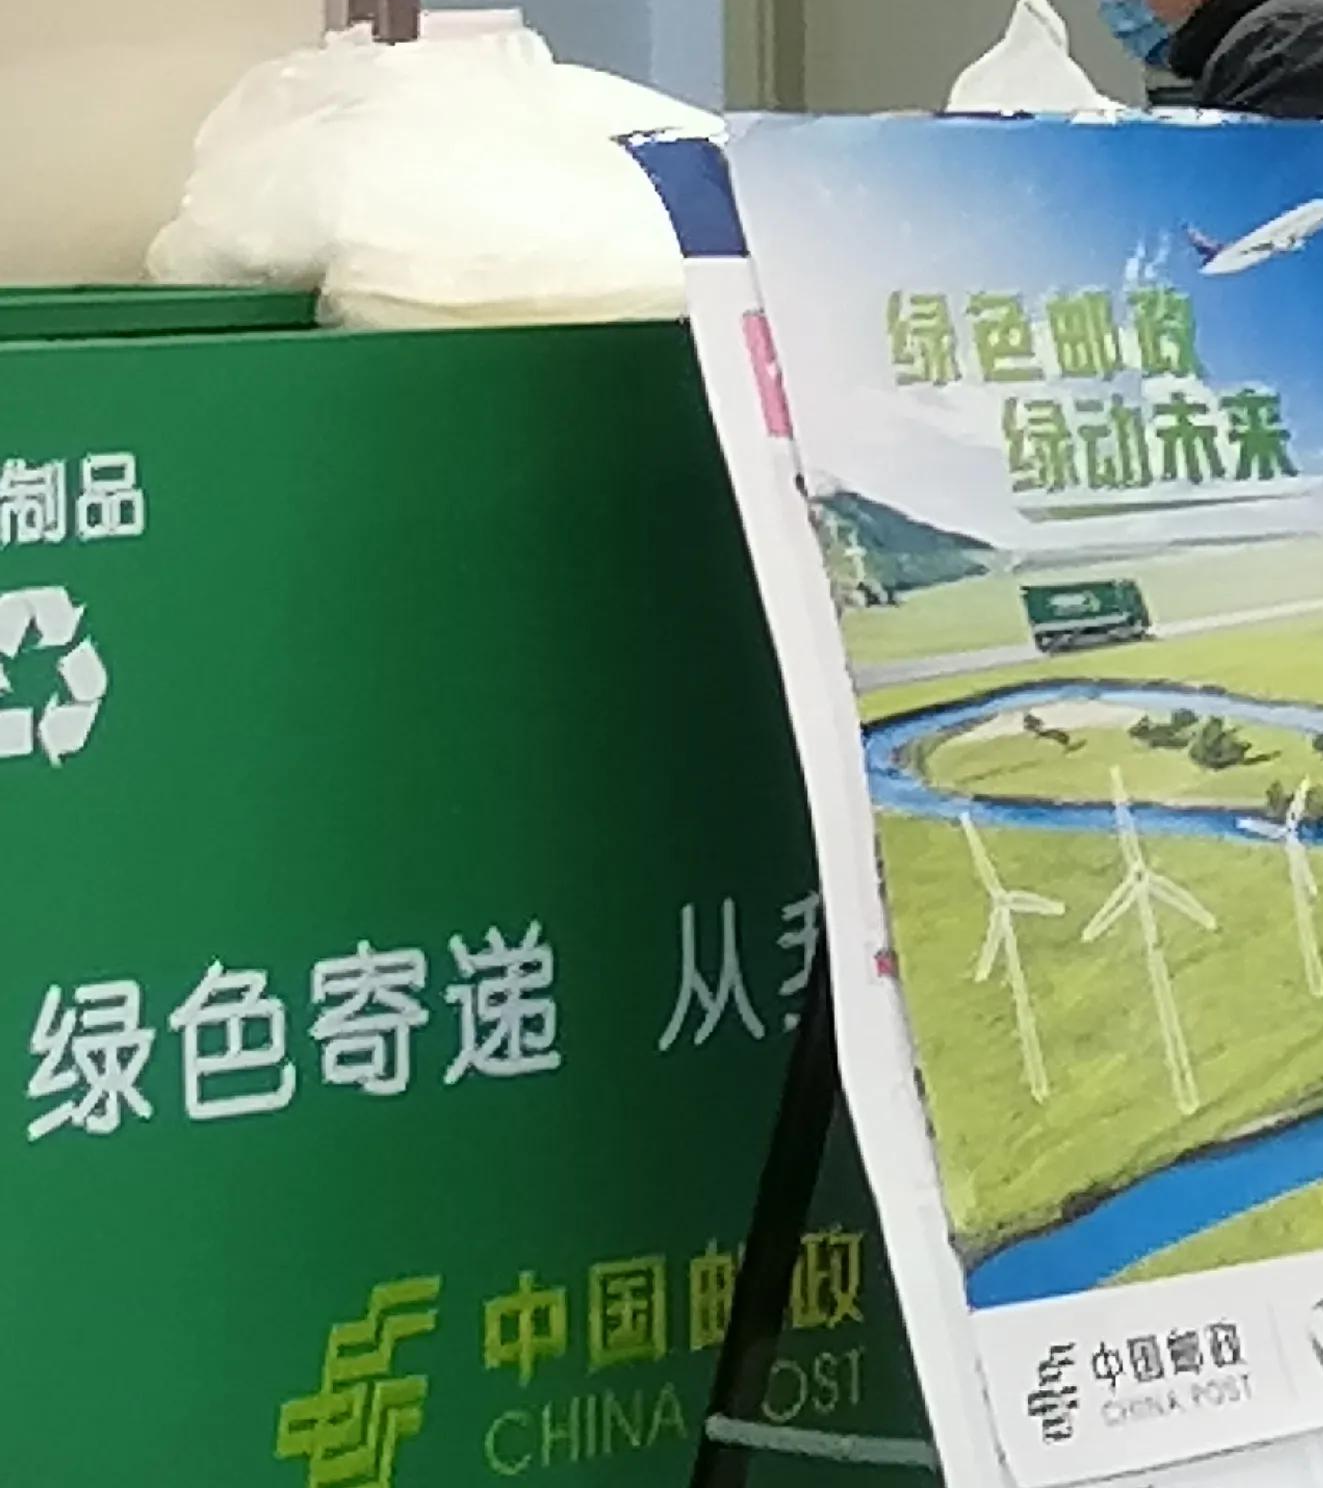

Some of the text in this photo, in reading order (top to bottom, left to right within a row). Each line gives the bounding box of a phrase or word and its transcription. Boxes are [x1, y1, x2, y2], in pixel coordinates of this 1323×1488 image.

[886, 288, 1202, 385] 绿色邮政
[1001, 389, 1300, 493] 绿动未来
[0, 451, 145, 550] 制品
[27, 921, 563, 1141] 绿色寄递
[1092, 1319, 1246, 1395] 中国邮政
[484, 1347, 865, 1476] CHINA OST
